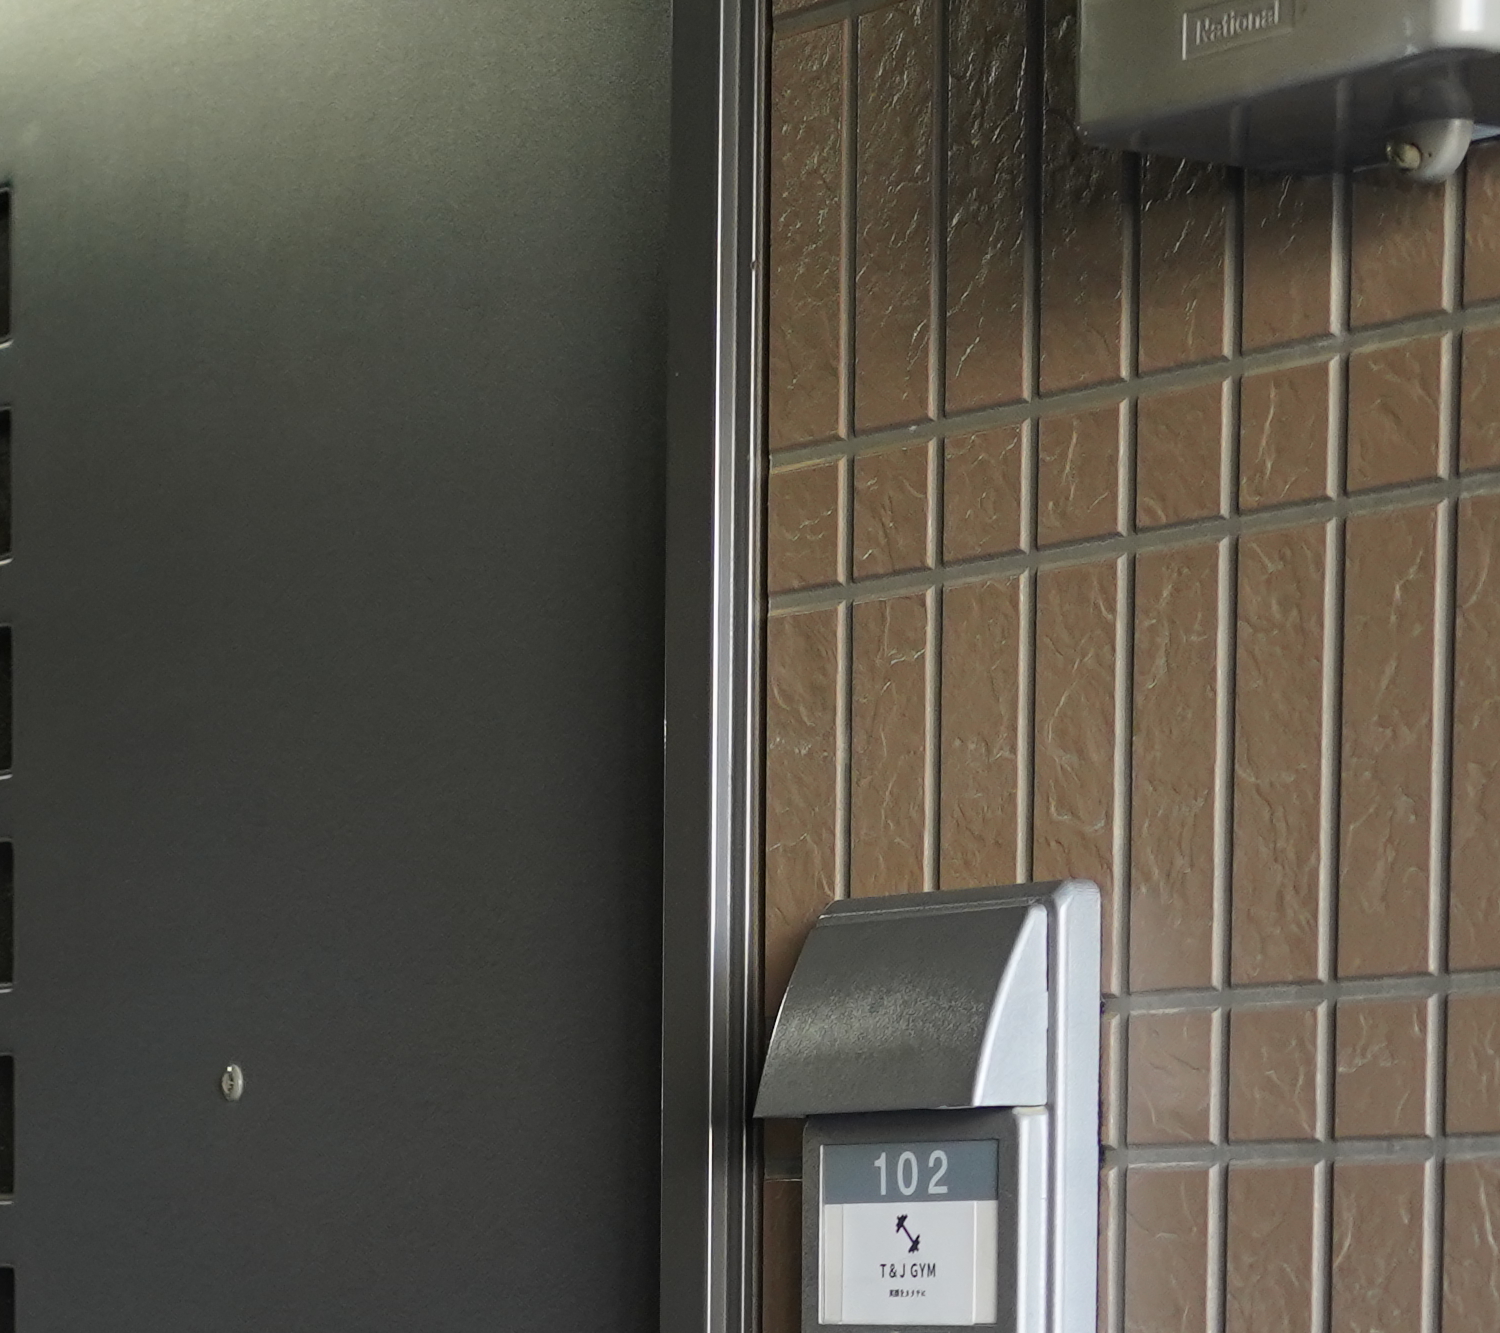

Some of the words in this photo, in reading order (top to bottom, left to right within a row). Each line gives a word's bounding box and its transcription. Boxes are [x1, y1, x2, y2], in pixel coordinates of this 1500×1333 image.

[1195, 0, 1281, 46] National
[873, 1149, 949, 1196] 102
[879, 1263, 906, 1279] T&J
[910, 1263, 937, 1278] GYM
